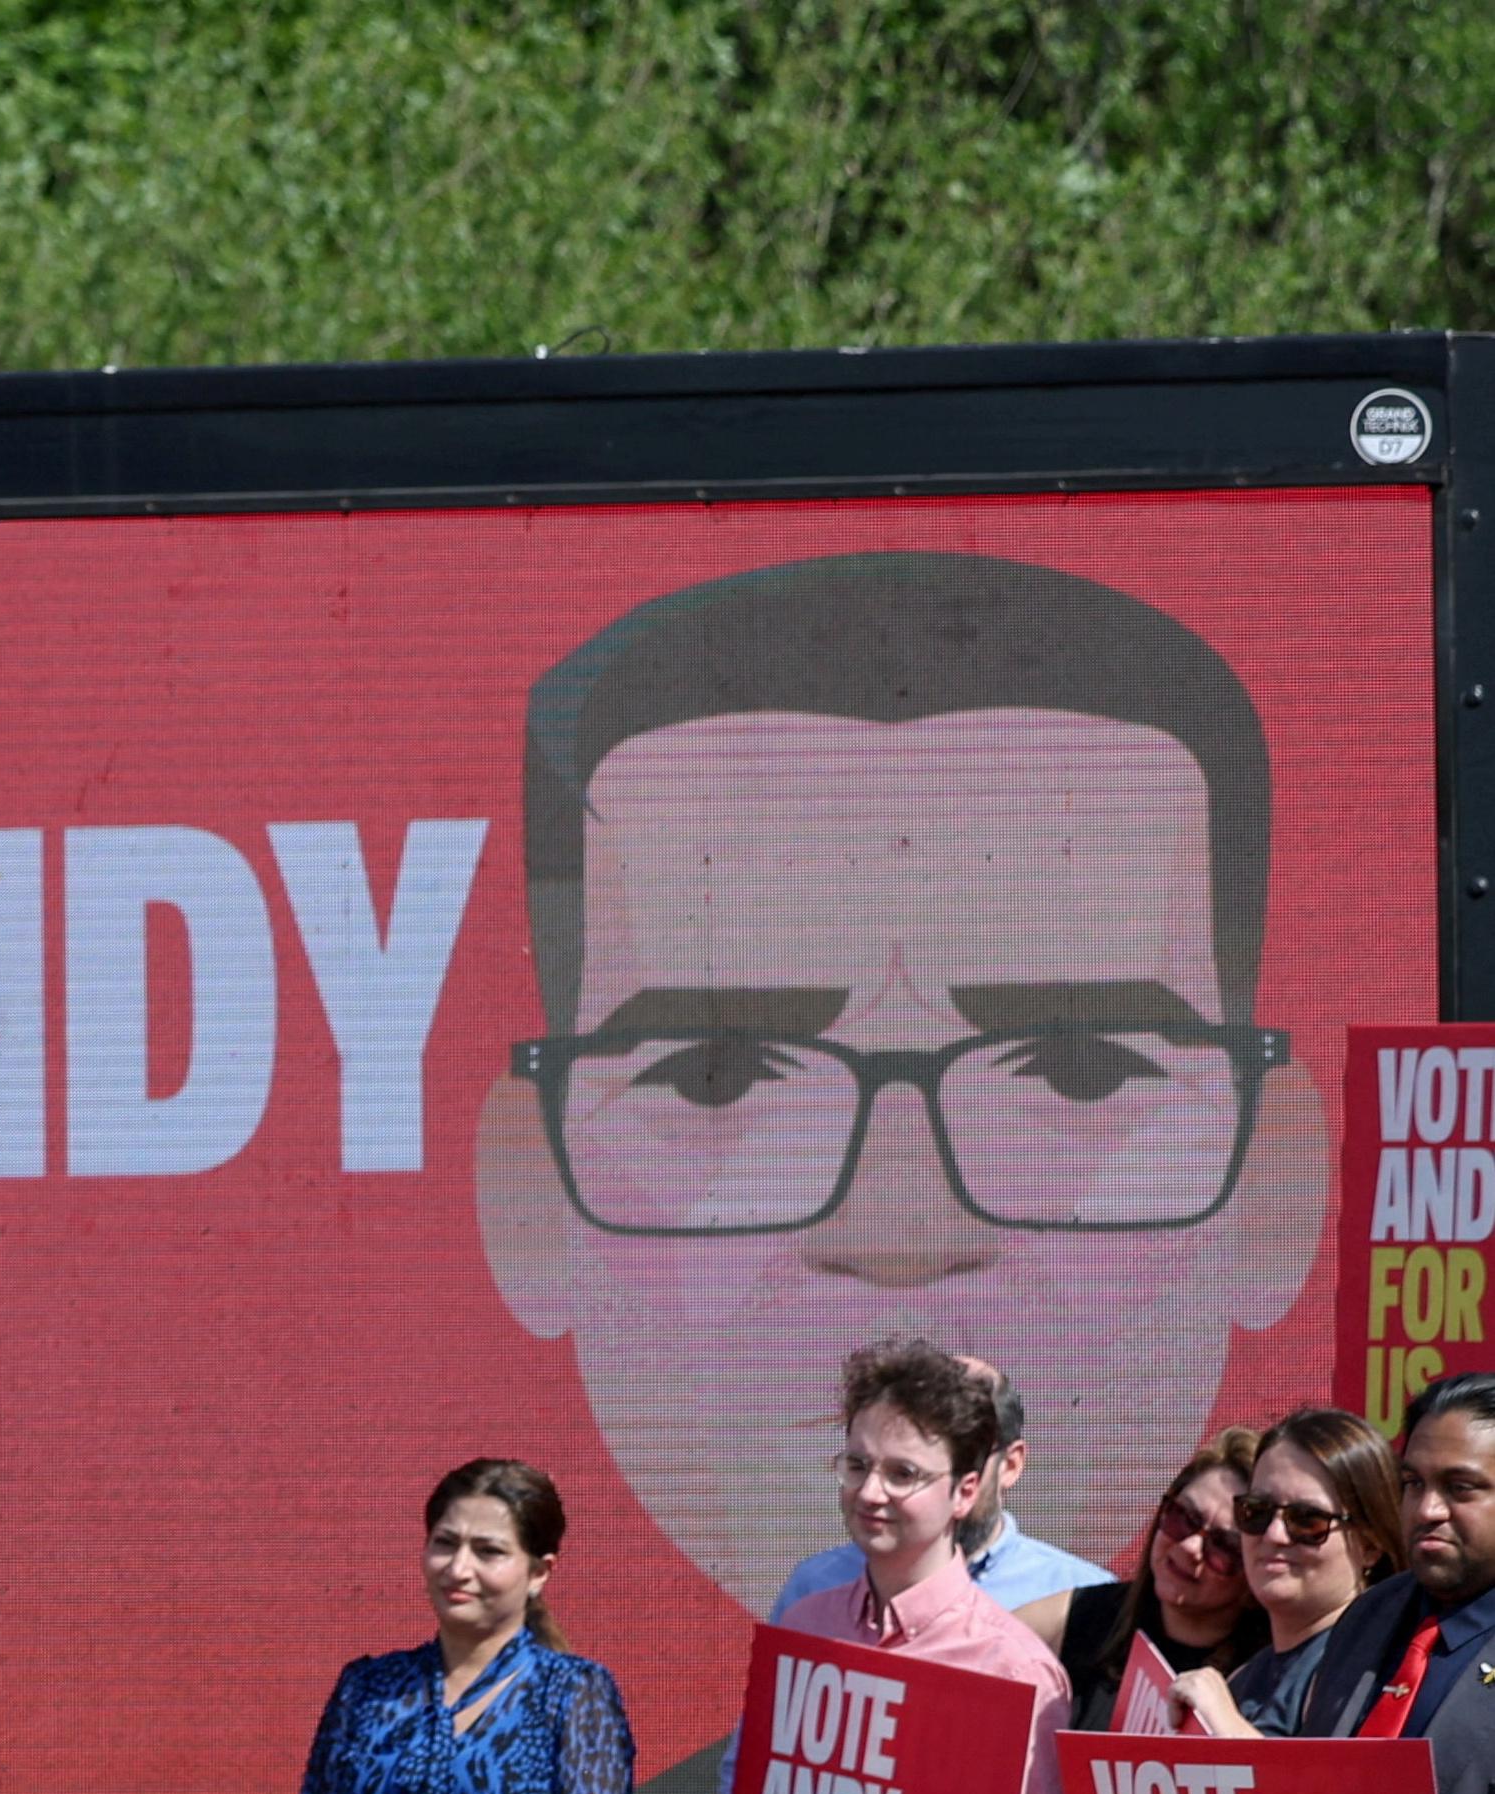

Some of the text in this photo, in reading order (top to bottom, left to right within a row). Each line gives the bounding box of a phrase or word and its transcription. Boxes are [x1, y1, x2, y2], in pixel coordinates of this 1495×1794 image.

[1378, 439, 1404, 456] D7
[1377, 1045, 1495, 1144] VOT
[1370, 1147, 1495, 1242] AND
[1367, 1246, 1487, 1342] FOR
[772, 1655, 906, 1780] VOTE
